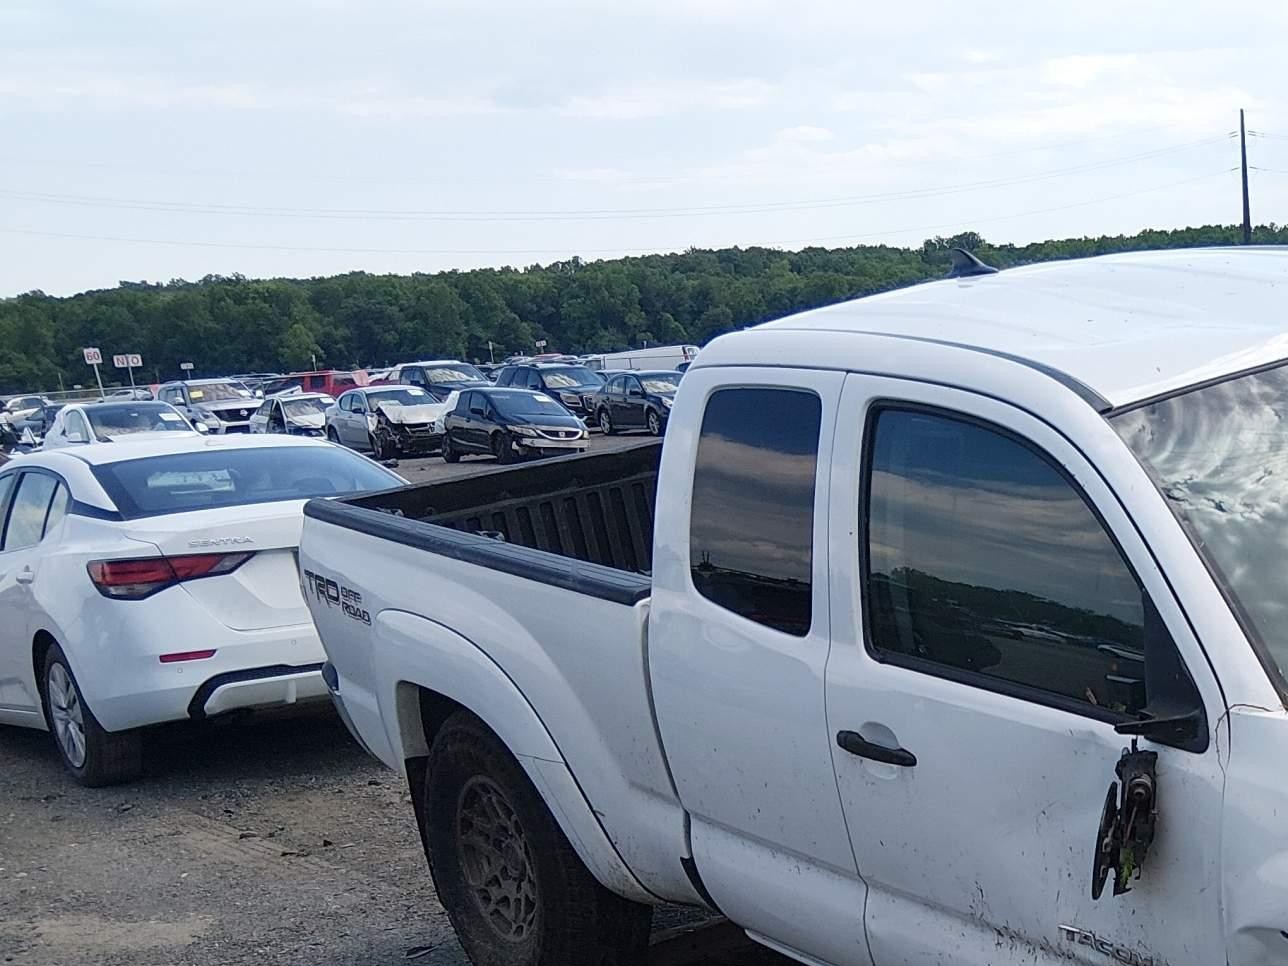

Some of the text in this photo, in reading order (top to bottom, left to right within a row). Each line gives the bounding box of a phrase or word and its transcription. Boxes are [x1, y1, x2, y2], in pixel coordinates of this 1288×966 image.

[86, 351, 100, 361] 60
[188, 536, 254, 548] SENTRA
[304, 569, 340, 607] TRD
[340, 585, 362, 604] OFF
[341, 602, 372, 627] ROAD
